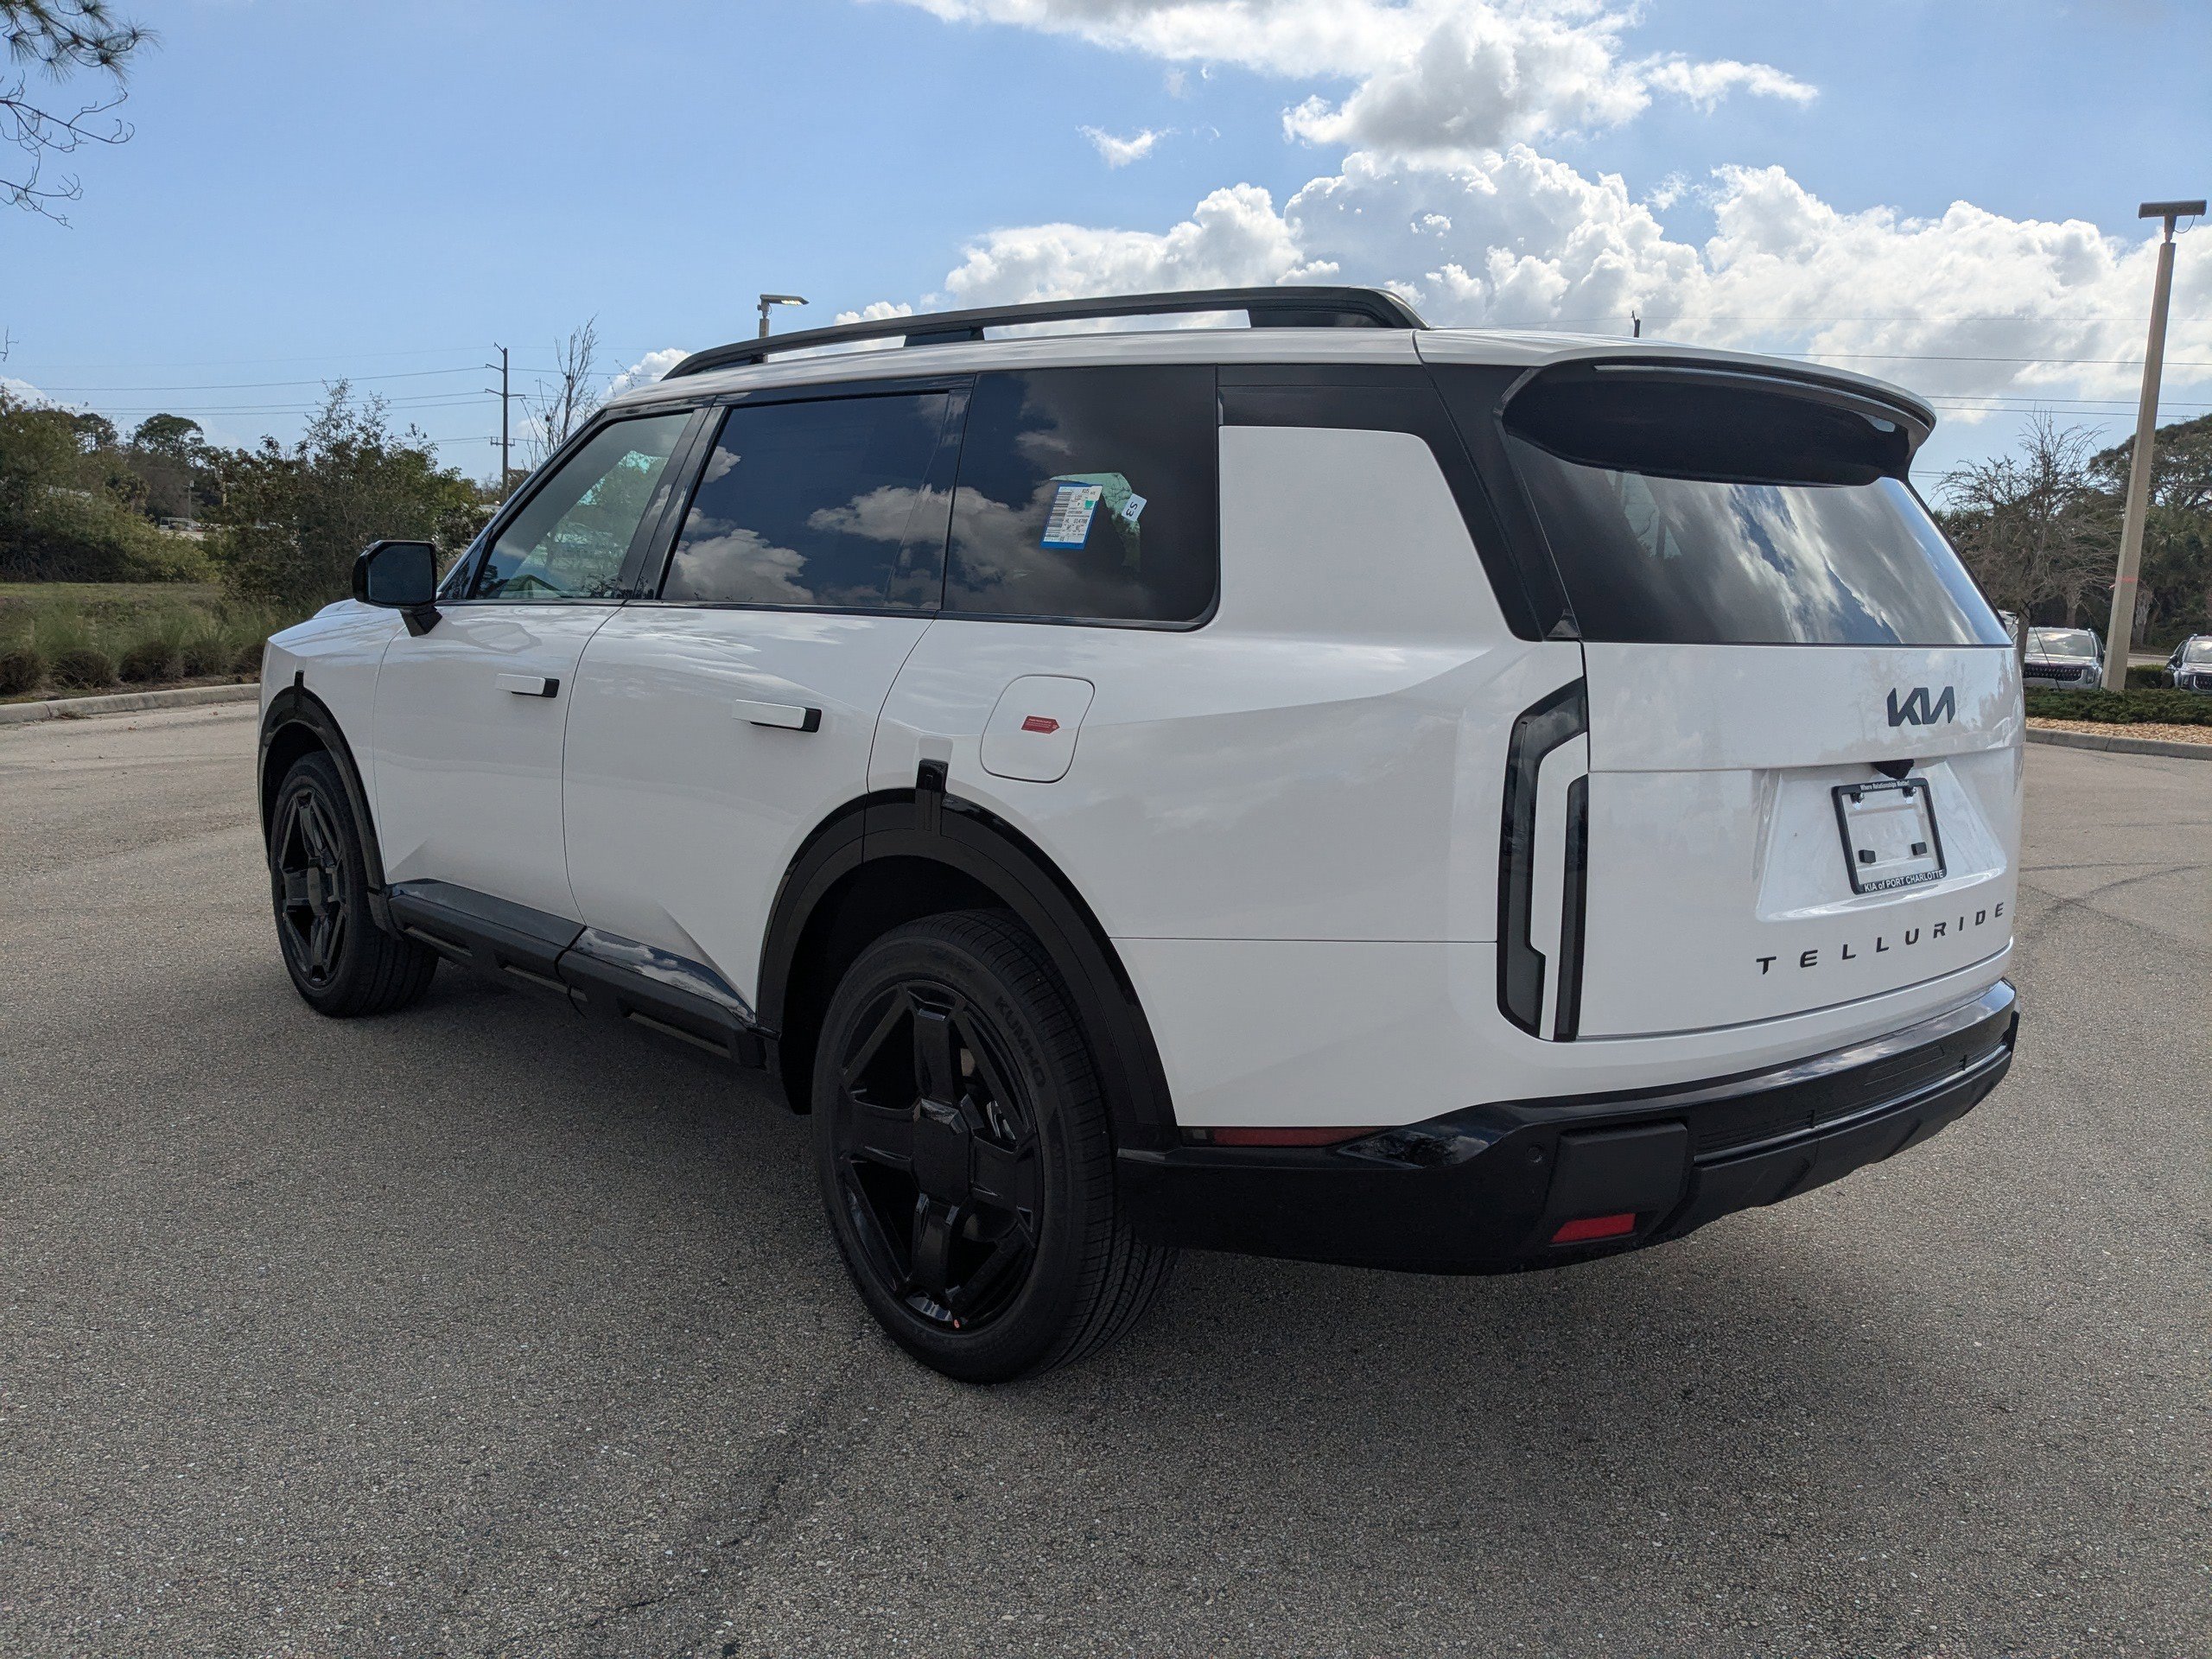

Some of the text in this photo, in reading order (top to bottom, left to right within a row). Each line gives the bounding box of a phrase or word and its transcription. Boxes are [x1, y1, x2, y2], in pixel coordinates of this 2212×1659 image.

[1125, 501, 1138, 517] S3
[1886, 686, 1955, 727] KIA
[1864, 870, 1944, 892] KIA of PORT CHARLOTTE
[1756, 902, 2005, 975] TELLURIDE
[994, 995, 1047, 1088] KUMHO
